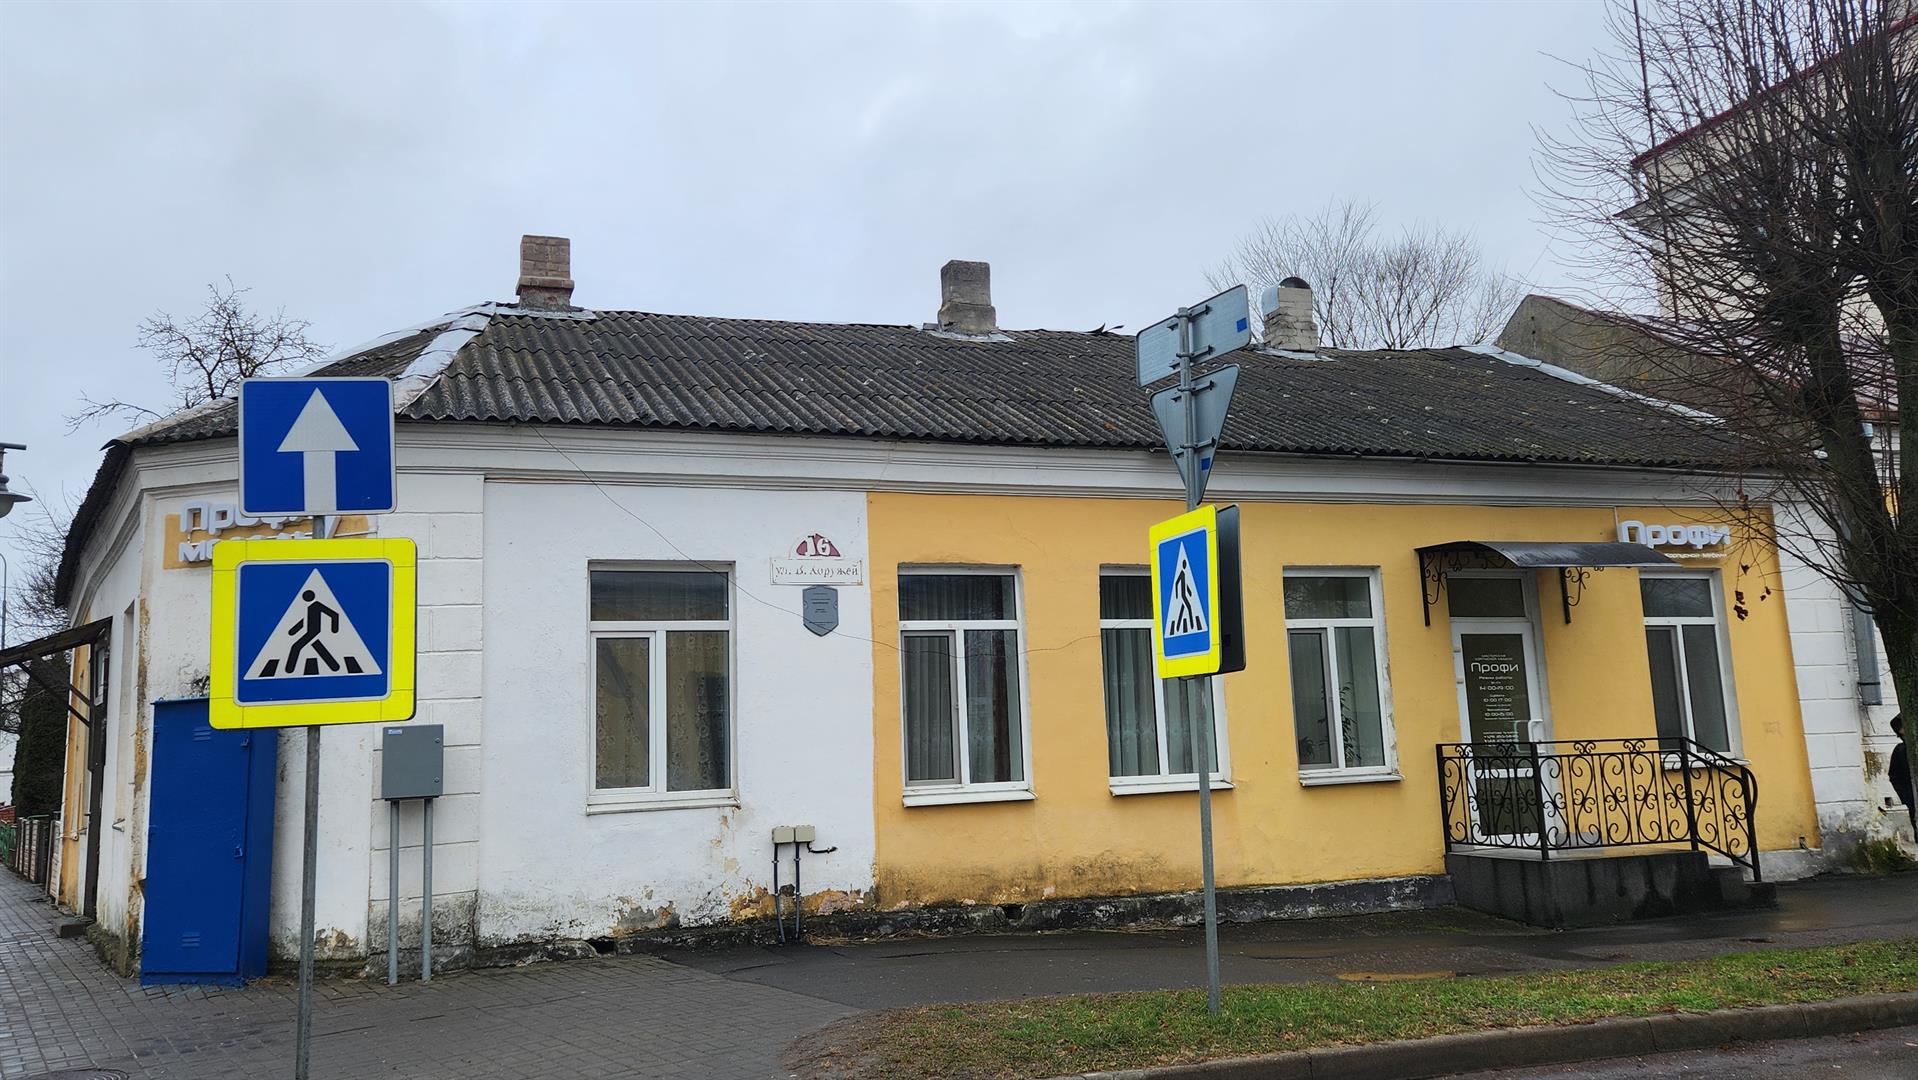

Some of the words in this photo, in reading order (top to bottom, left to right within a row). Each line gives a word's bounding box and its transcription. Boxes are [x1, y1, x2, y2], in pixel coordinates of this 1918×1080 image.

[804, 534, 831, 556] 16
[1618, 520, 1731, 549] Профи
[1470, 662, 1519, 674] Профи
